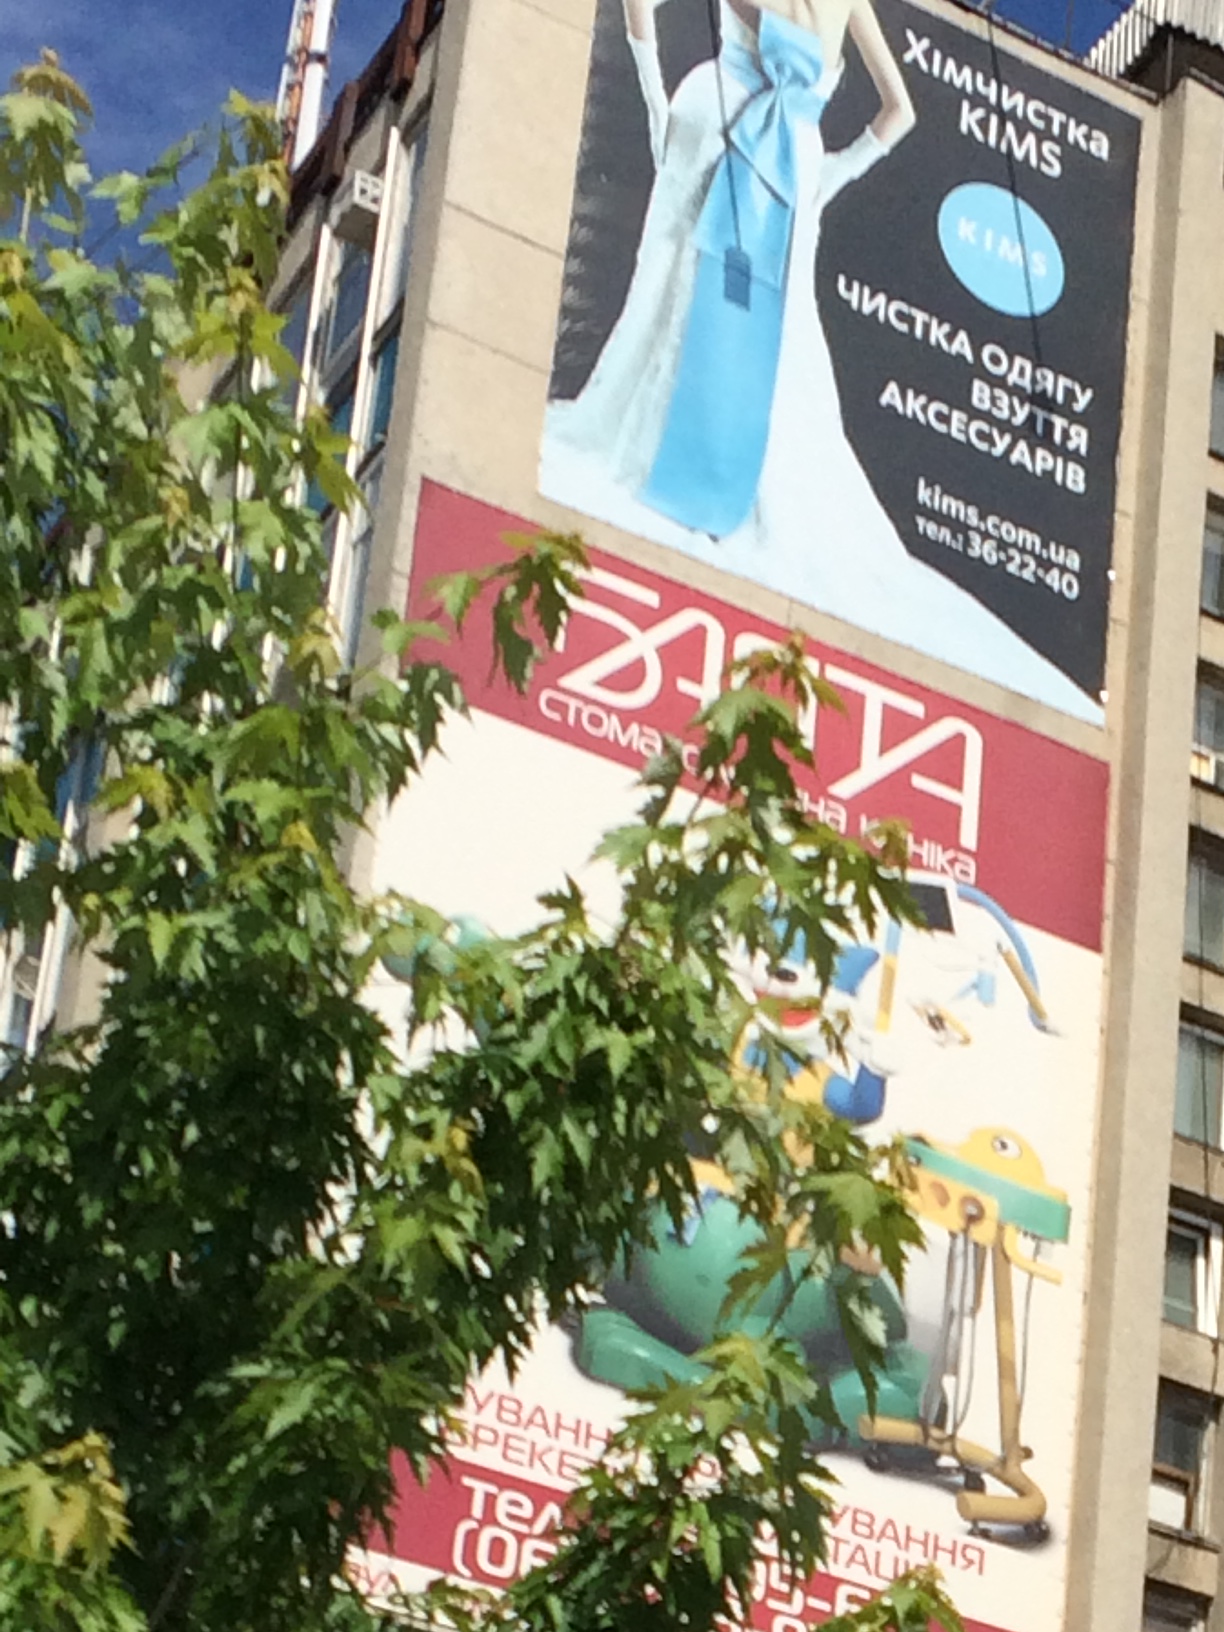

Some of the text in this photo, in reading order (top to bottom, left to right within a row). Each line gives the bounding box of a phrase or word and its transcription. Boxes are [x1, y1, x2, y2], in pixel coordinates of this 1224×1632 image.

[958, 100, 1062, 179] KIMS
[956, 216, 1047, 278] KIMS
[837, 273, 1093, 417] ЧИСТКА ОДЯГУ
[880, 380, 1086, 495] АКСЕСУАРІВ
[971, 377, 1089, 457] ВЗУТТЯ
[918, 478, 1081, 573] kims.com.ua
[966, 530, 1079, 602] 36-22-40
